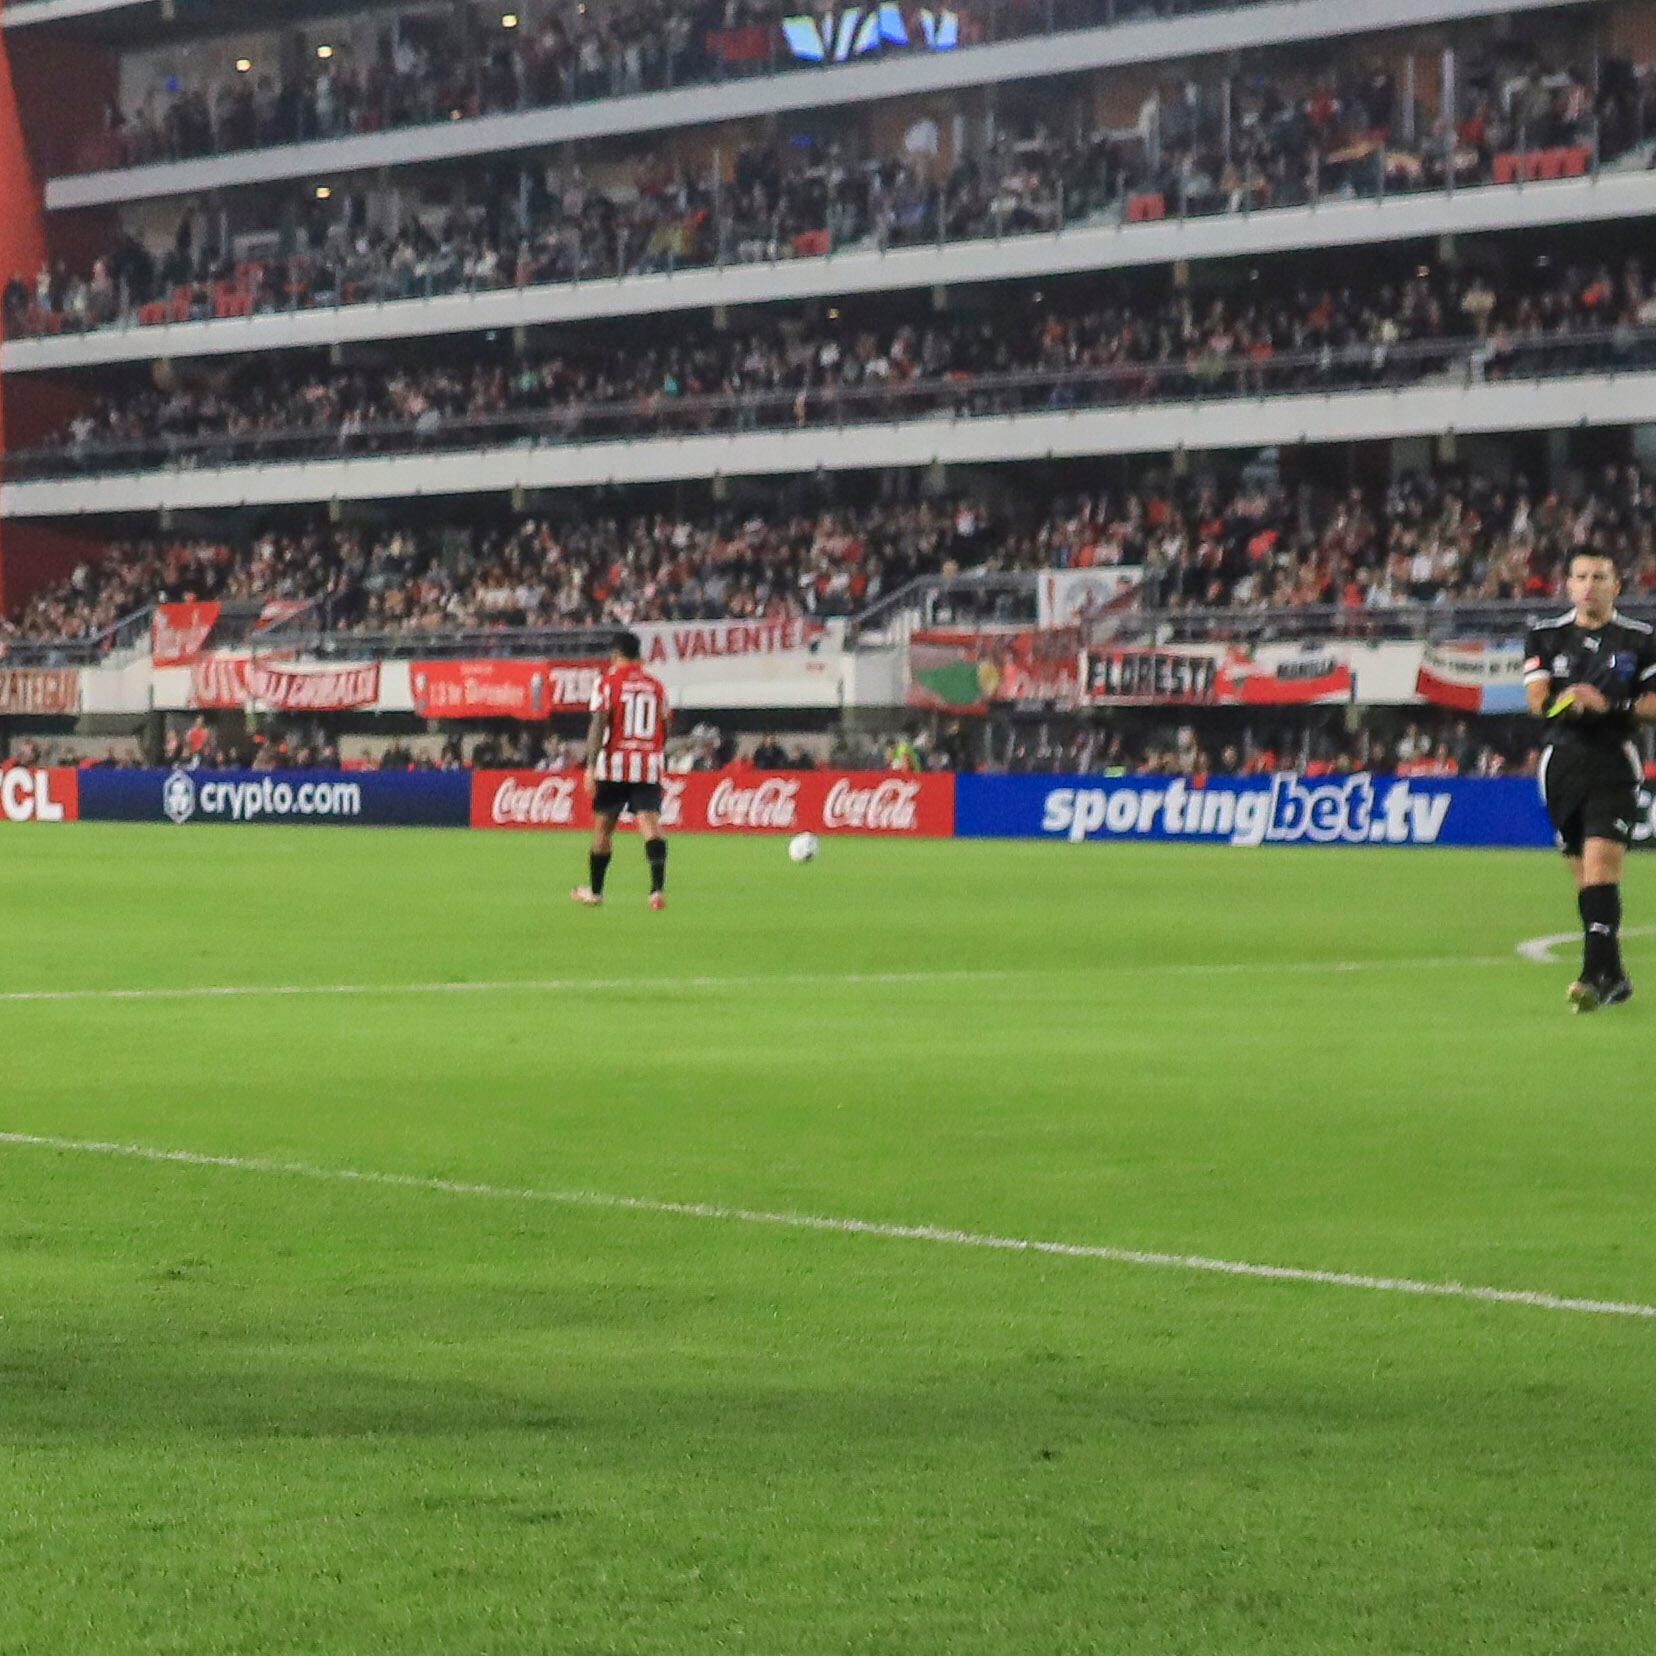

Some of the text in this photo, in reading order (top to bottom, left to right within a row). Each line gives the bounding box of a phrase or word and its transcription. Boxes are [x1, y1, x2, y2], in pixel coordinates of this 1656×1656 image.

[619, 691, 657, 740] 10
[200, 779, 361, 821] crypto.com
[1043, 771, 1452, 846] sportingbet.tv
